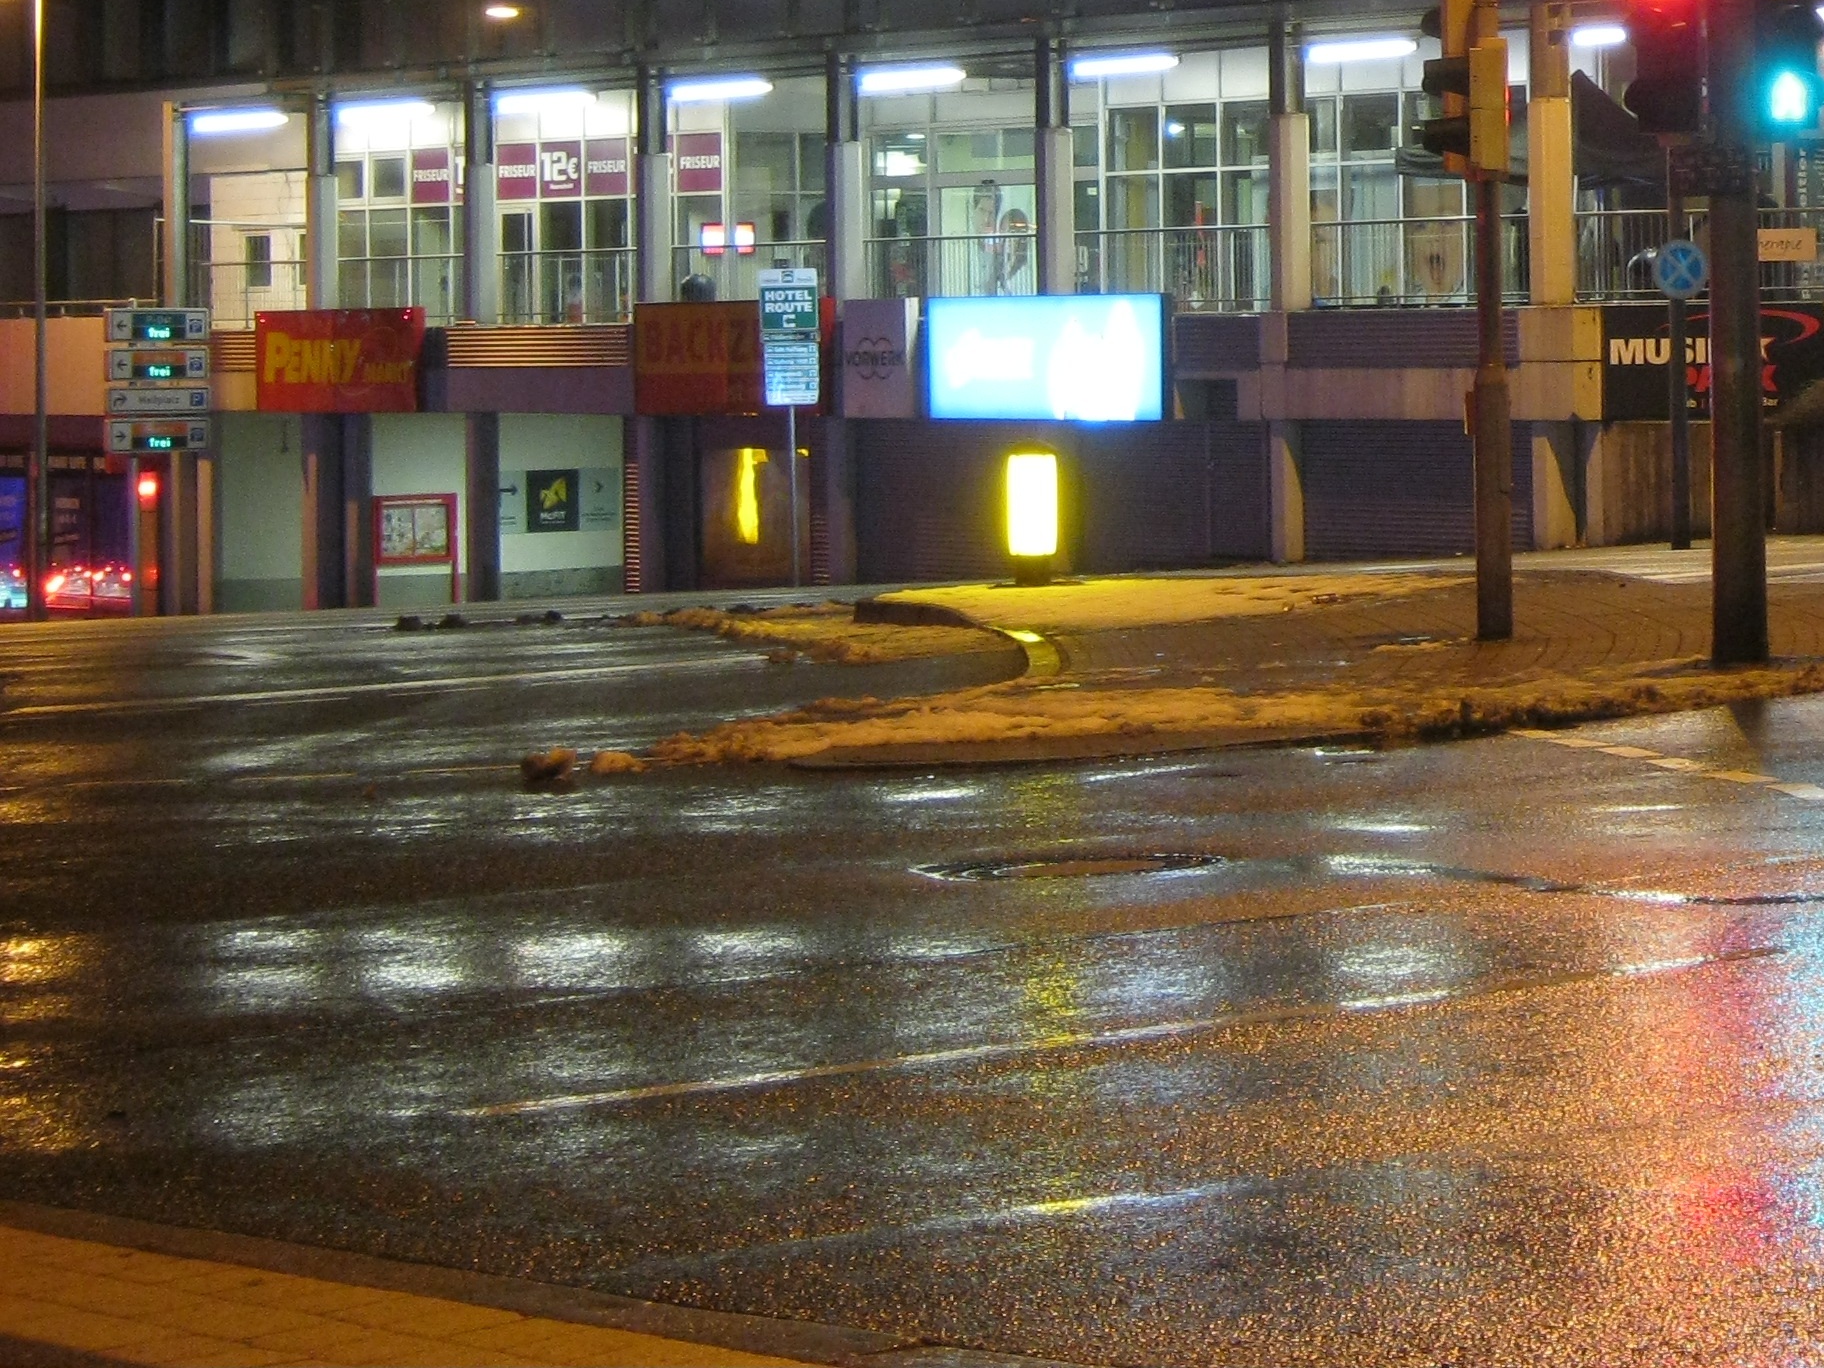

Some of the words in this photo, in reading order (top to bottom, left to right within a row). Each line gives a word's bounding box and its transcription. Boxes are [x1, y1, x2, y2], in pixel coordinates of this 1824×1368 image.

[499, 164, 536, 178] FRISEUR
[540, 150, 579, 182] 12€
[587, 160, 626, 174] FRISEUR
[679, 155, 720, 169] FRISEUR
[413, 168, 449, 182] FRISEUR
[764, 290, 813, 301] HOTEL
[764, 302, 813, 313] ROUTE
[782, 314, 796, 328] C
[148, 327, 170, 338] frei
[264, 331, 362, 384] PENNY
[148, 366, 171, 377] frei
[148, 437, 171, 448] frei
